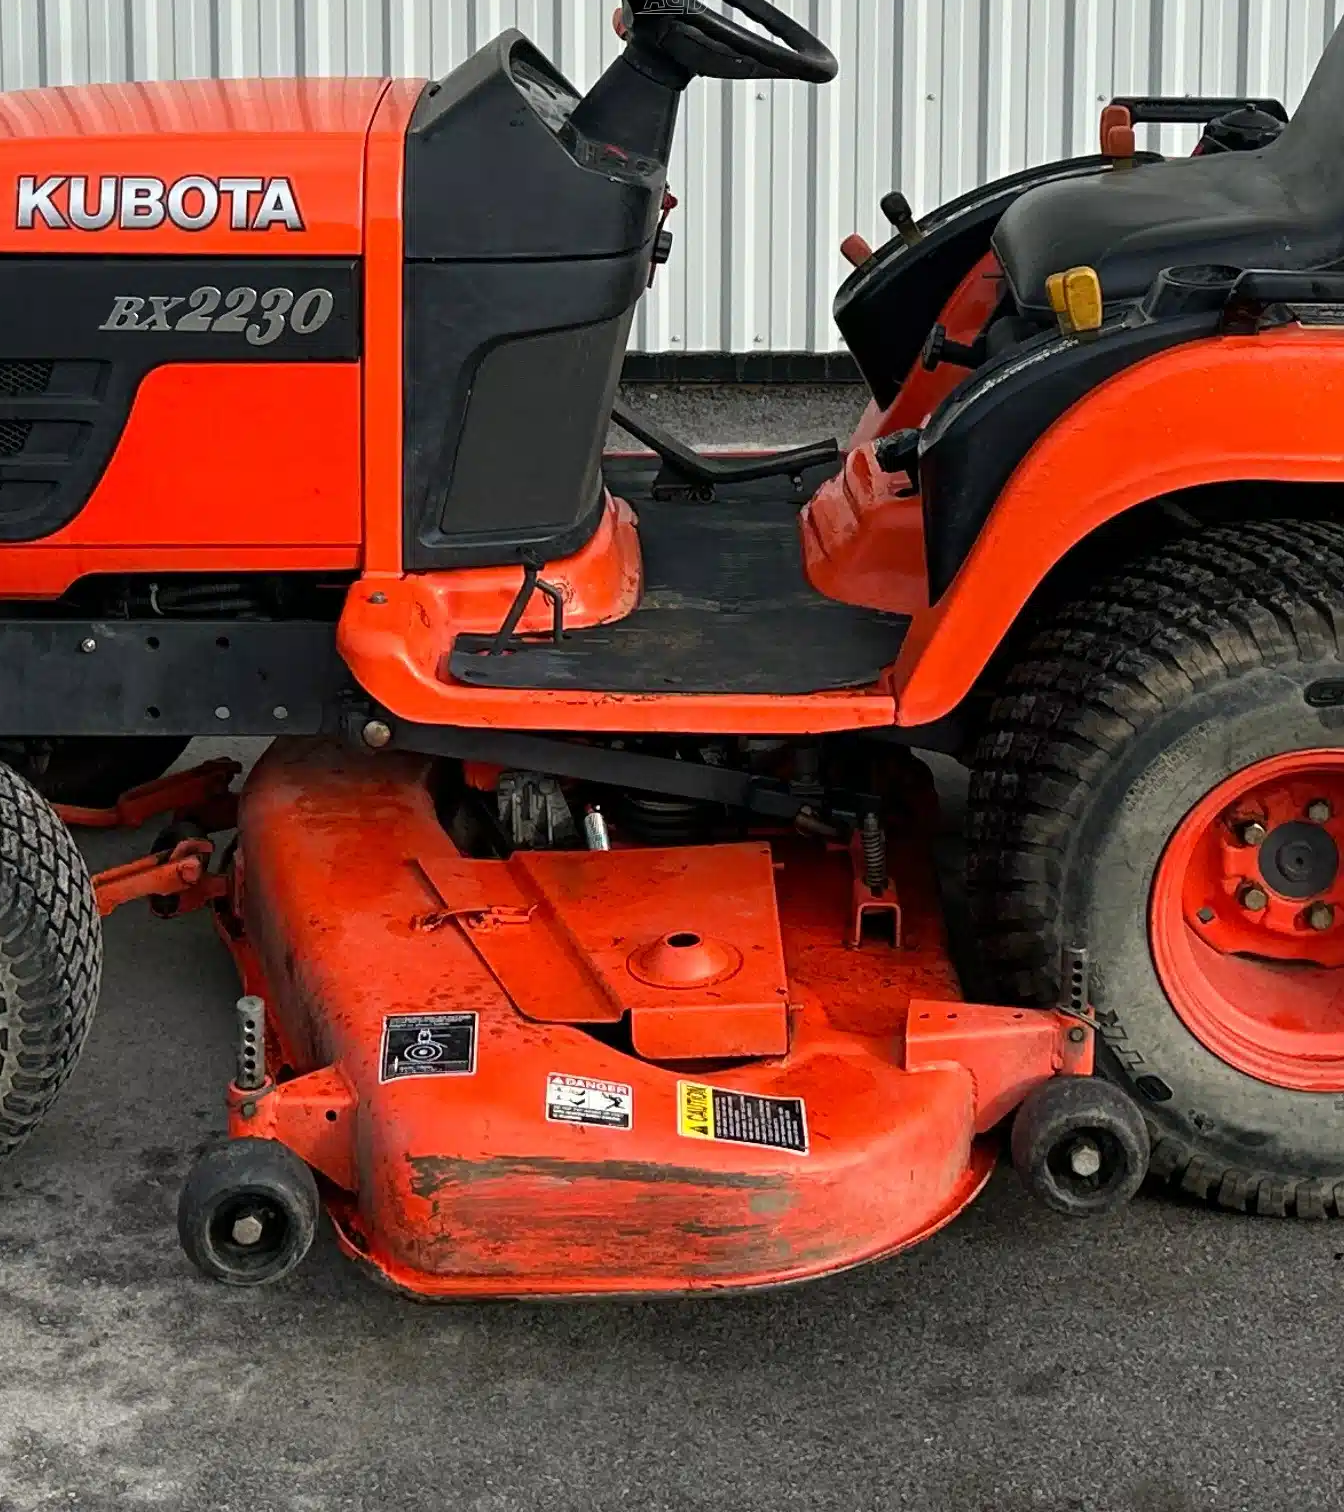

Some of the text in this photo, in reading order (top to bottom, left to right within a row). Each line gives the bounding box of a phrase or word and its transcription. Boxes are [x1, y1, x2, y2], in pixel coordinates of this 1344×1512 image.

[15, 175, 305, 232] KUBOTA
[98, 286, 334, 346] BX2230
[565, 1078, 628, 1096] DANGER
